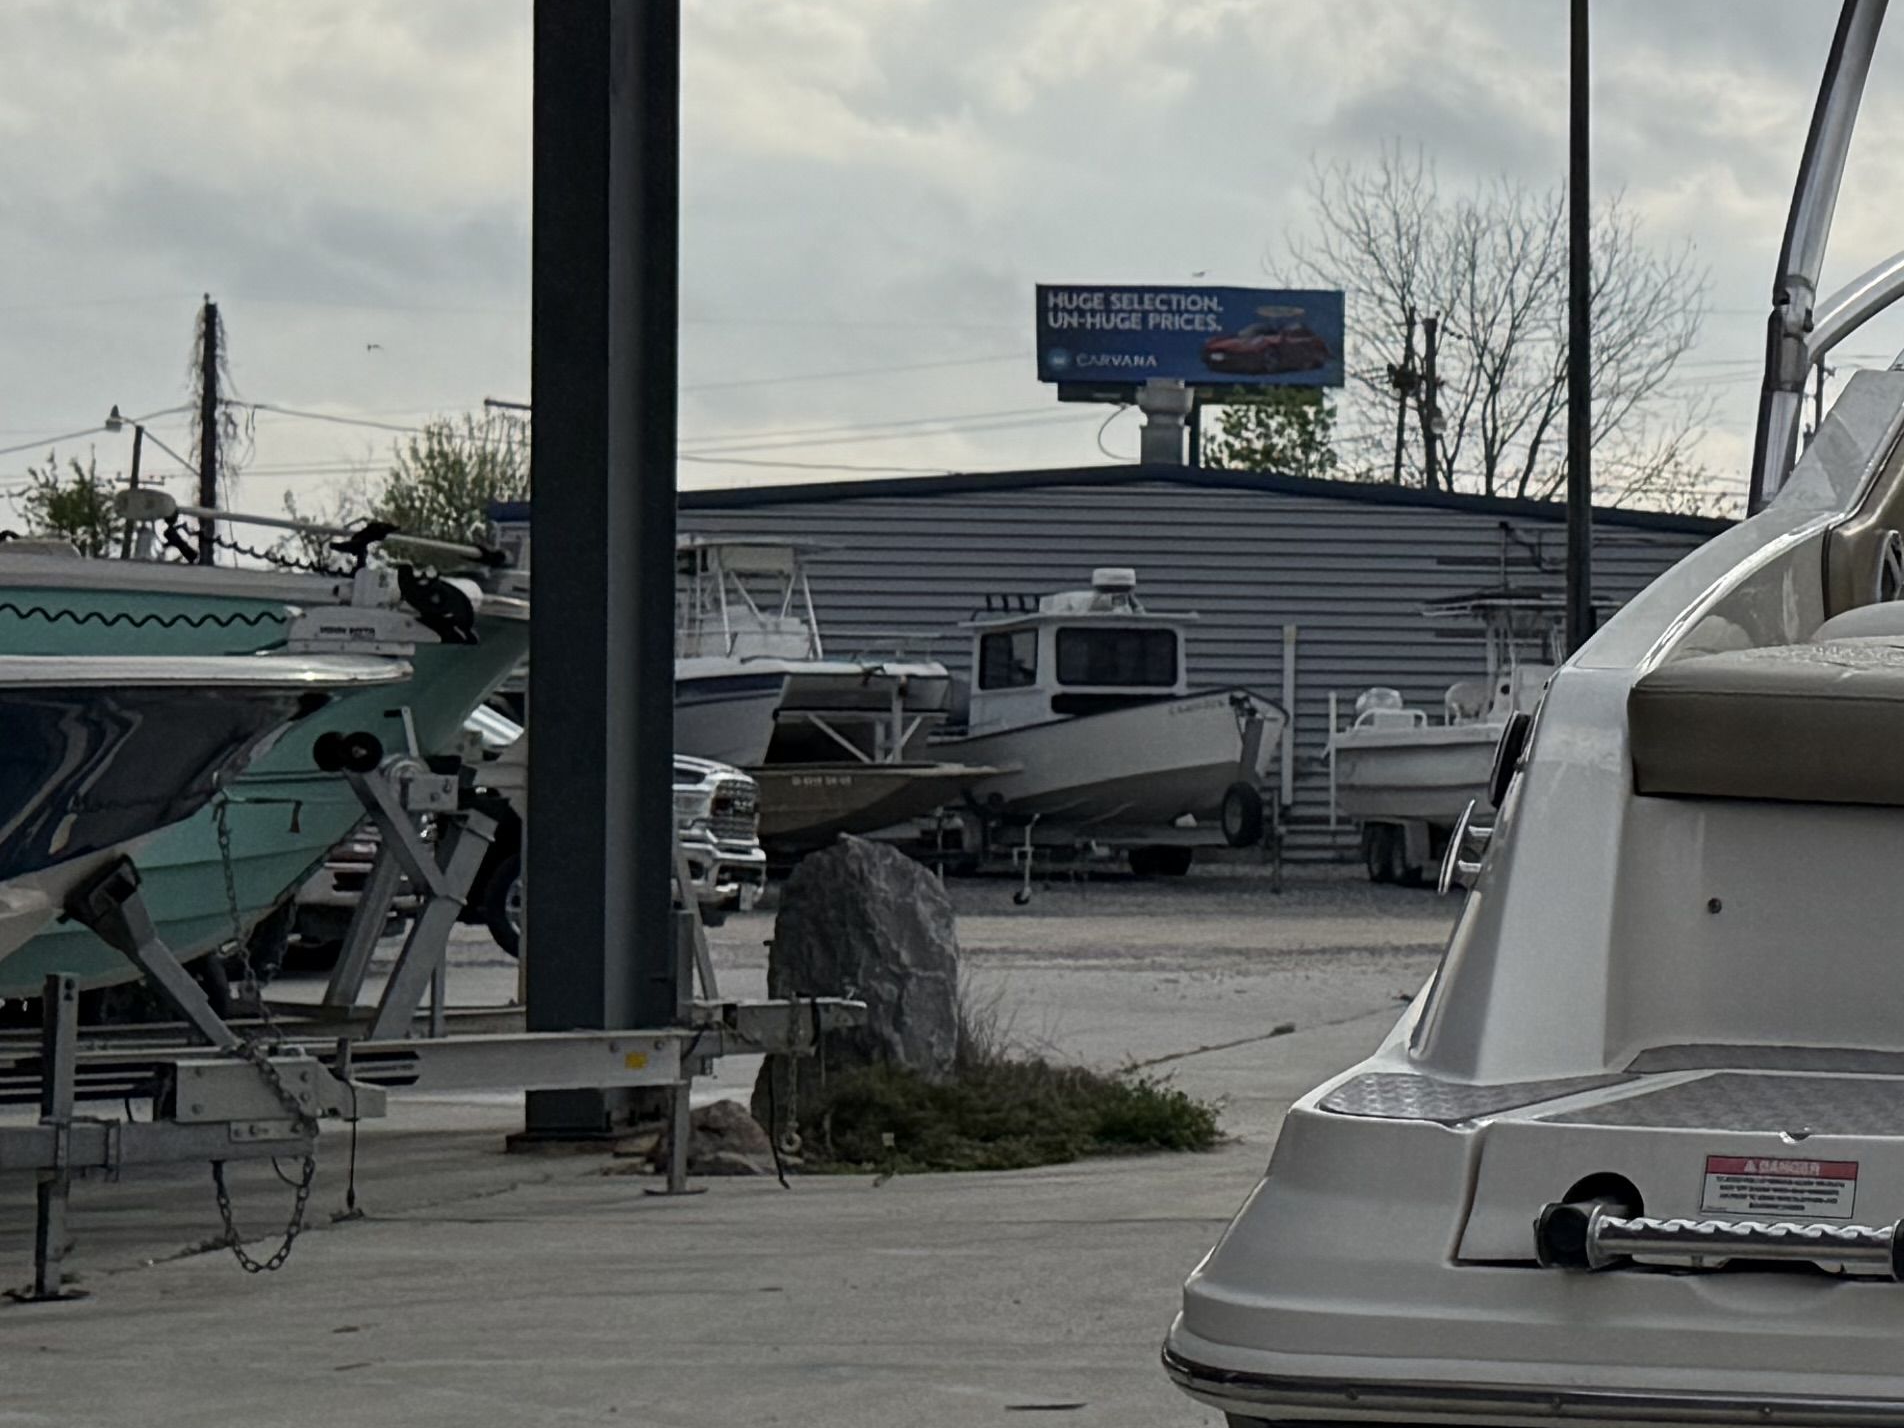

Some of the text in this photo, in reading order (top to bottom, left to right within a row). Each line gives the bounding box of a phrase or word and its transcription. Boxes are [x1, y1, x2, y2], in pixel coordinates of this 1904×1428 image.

[1048, 291, 1224, 312] HUGE SELECTION.
[1048, 311, 1223, 332] UN-HUGE PRICES.
[1076, 353, 1157, 368] CARVANA
